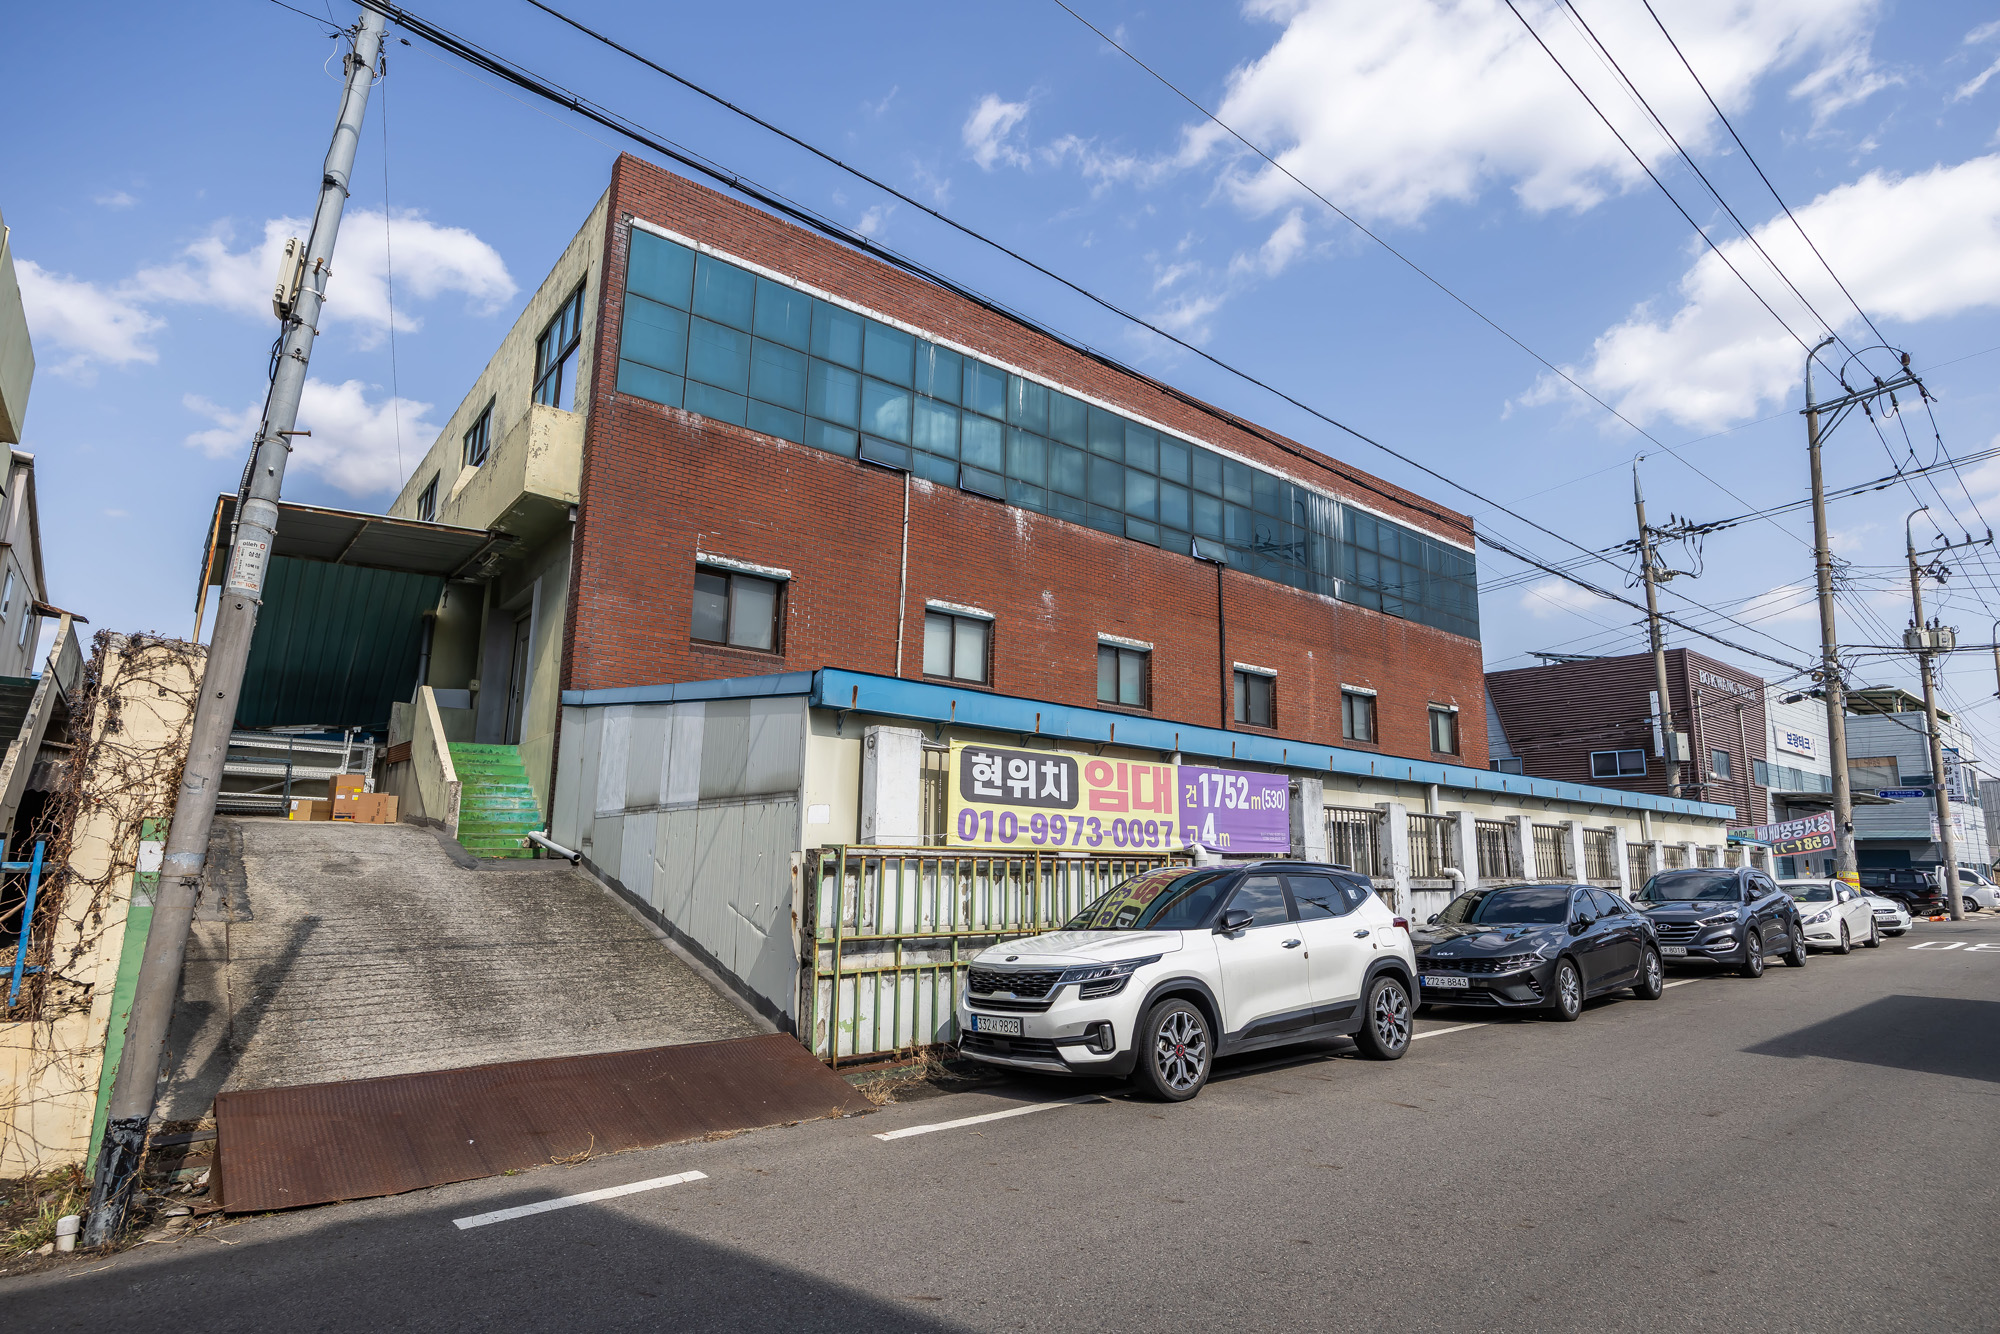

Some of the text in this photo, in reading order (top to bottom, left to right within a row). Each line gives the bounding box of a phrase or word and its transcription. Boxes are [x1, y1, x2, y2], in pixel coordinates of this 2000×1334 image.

[1786, 731, 1811, 750] 보광테크
[971, 752, 1173, 815] 현위치 임대
[1185, 784, 1198, 808] 건
[957, 807, 1174, 848] 010-9973-0097
